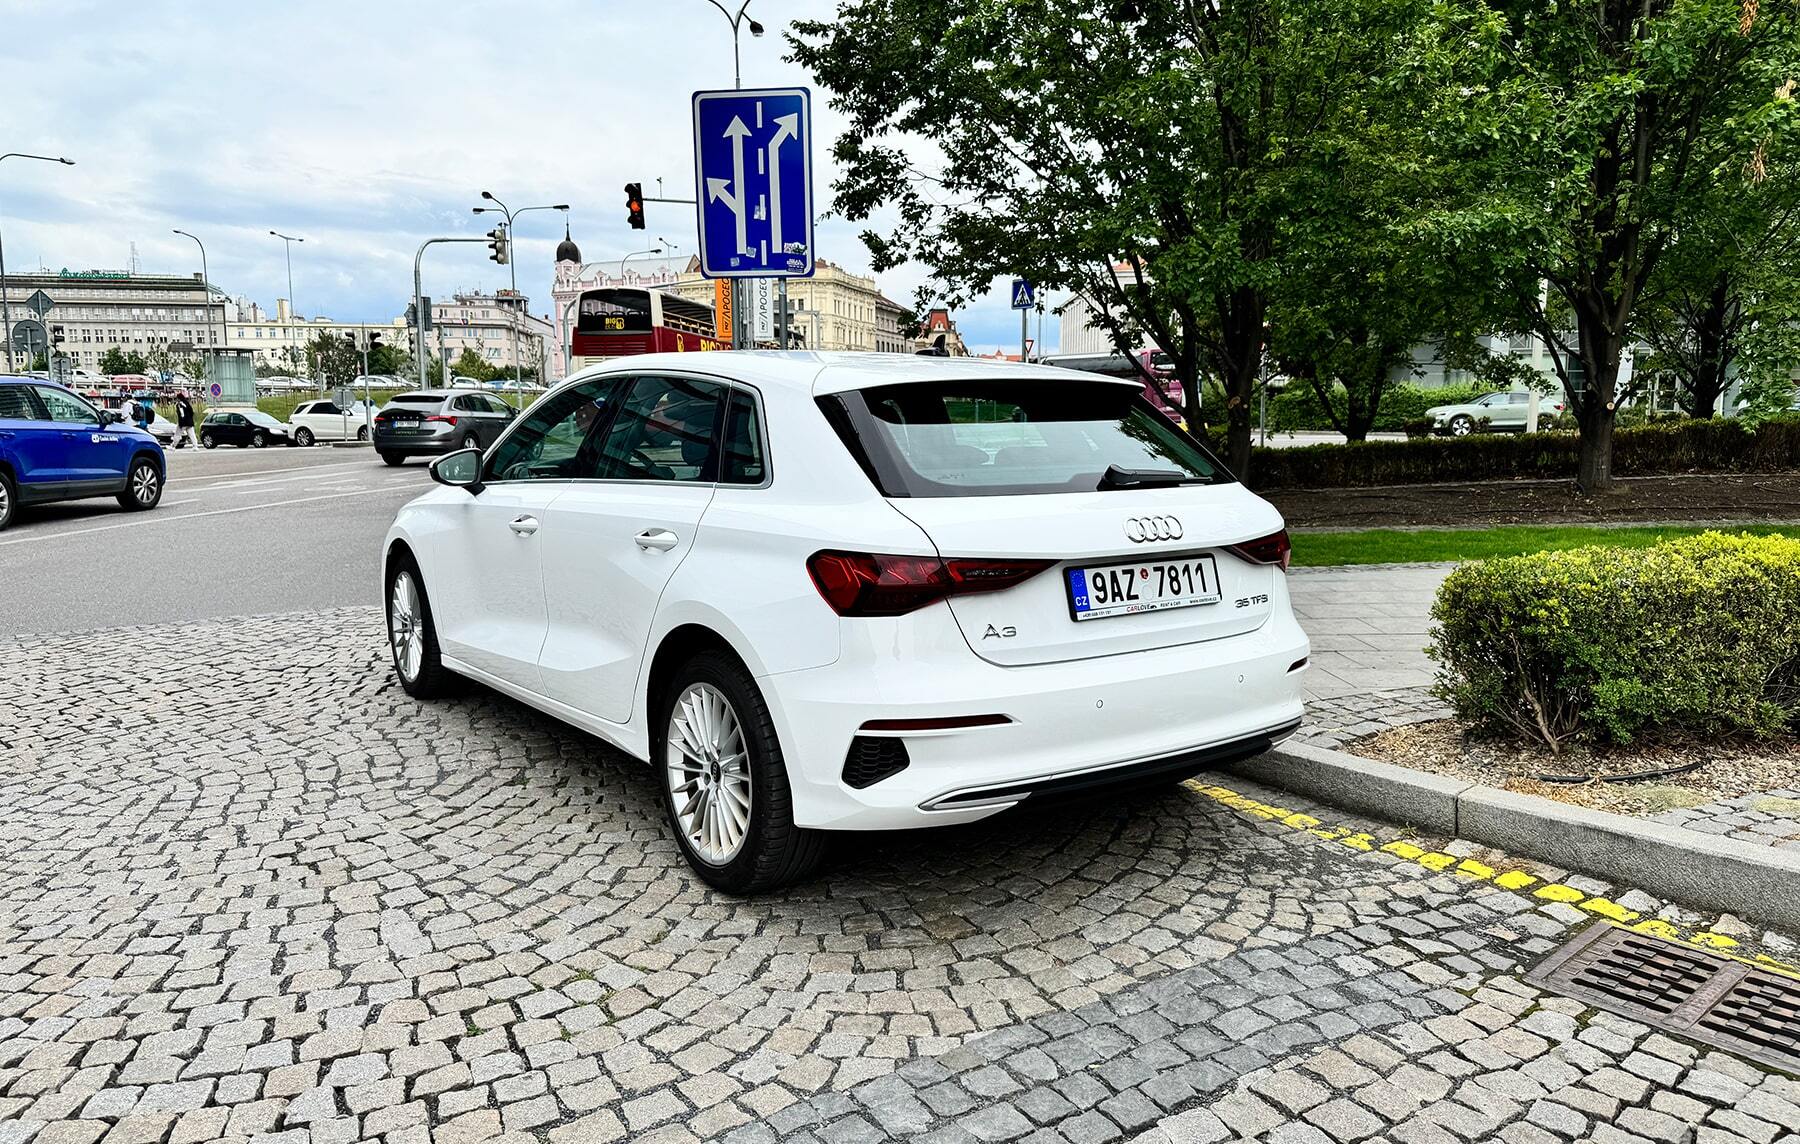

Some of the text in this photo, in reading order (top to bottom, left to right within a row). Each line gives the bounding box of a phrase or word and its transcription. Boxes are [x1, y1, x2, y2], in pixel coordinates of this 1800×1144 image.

[1092, 562, 1207, 604] 9AZ 7811
[1075, 596, 1088, 606] CZ
[1234, 597, 1250, 608] 35
[981, 624, 1017, 640] A3
